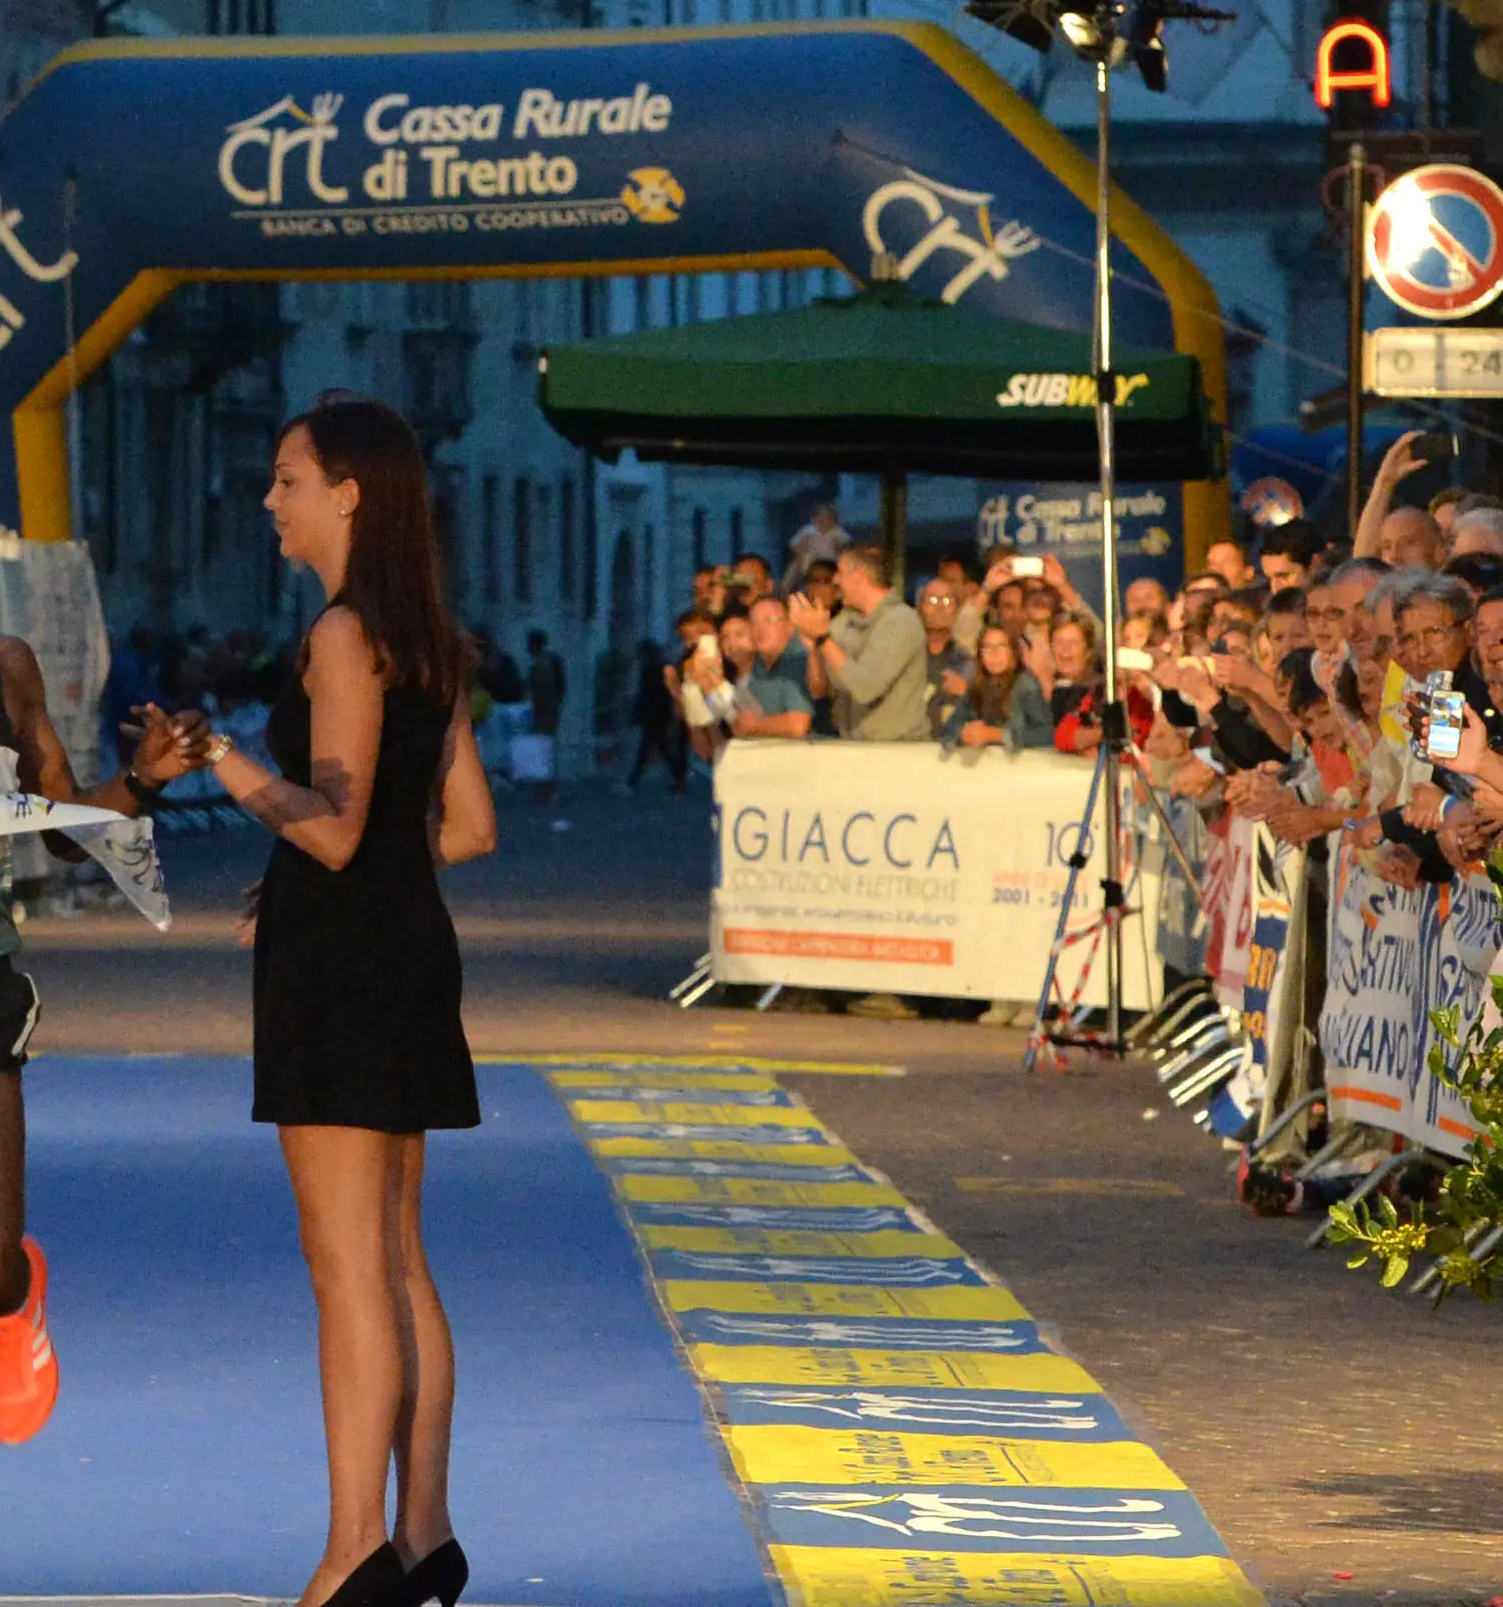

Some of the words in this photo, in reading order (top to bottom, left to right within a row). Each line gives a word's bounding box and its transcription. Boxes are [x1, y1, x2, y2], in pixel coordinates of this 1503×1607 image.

[363, 94, 503, 144] Cassa
[514, 82, 672, 138] Rurale
[363, 150, 408, 200] di
[421, 146, 578, 198] Trento
[261, 216, 336, 237] BANCA
[342, 215, 367, 234] DI
[373, 212, 469, 234] CREDITO
[474, 205, 630, 232] COOPERATIVO
[997, 373, 1148, 407] SUBWY
[732, 806, 960, 870] GIACCA
[1049, 890, 1089, 909] 211
